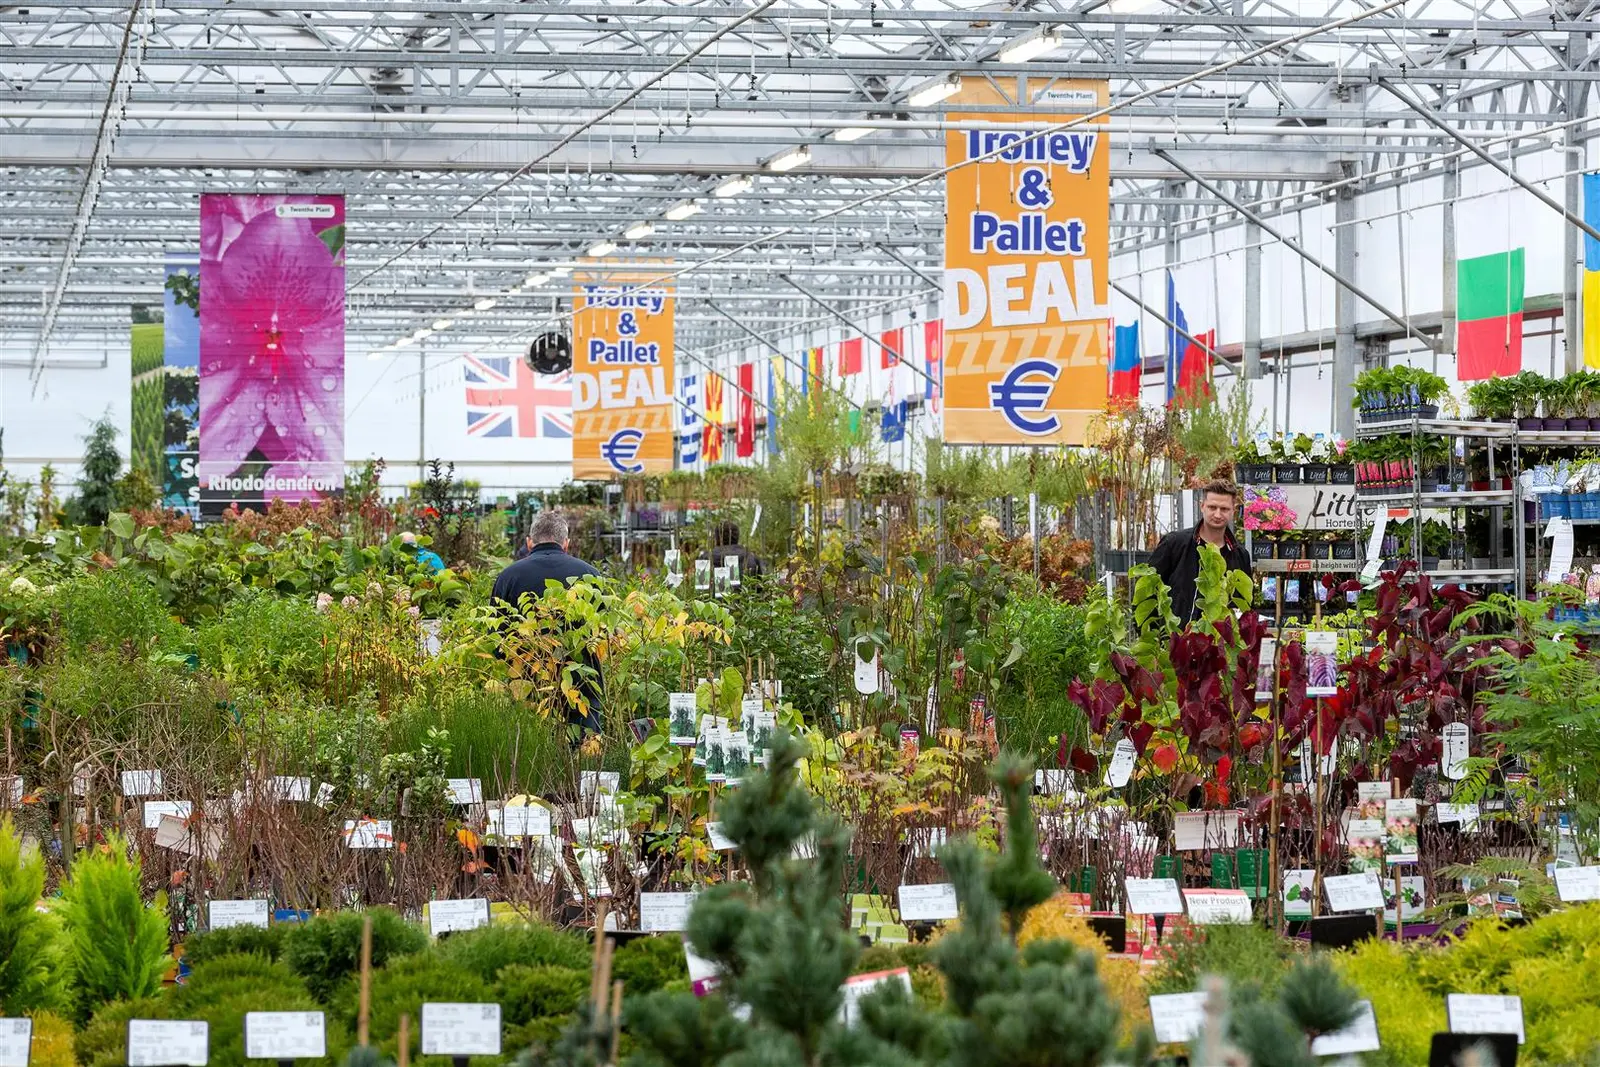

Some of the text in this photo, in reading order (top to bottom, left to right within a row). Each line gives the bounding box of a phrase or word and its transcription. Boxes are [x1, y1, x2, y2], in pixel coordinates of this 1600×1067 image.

[965, 123, 1095, 171] Trolley
[1019, 169, 1050, 206] &
[973, 214, 1082, 252] Pallet
[583, 285, 664, 312] Trolley
[945, 259, 1108, 331] DEAL
[618, 312, 638, 335] &
[590, 340, 657, 362] Pallet
[573, 366, 673, 412] DEAL
[208, 474, 337, 492] Rhododendron
[1311, 490, 1376, 518] Litte
[1325, 517, 1376, 528] Hortesia
[1320, 561, 1342, 570] height
